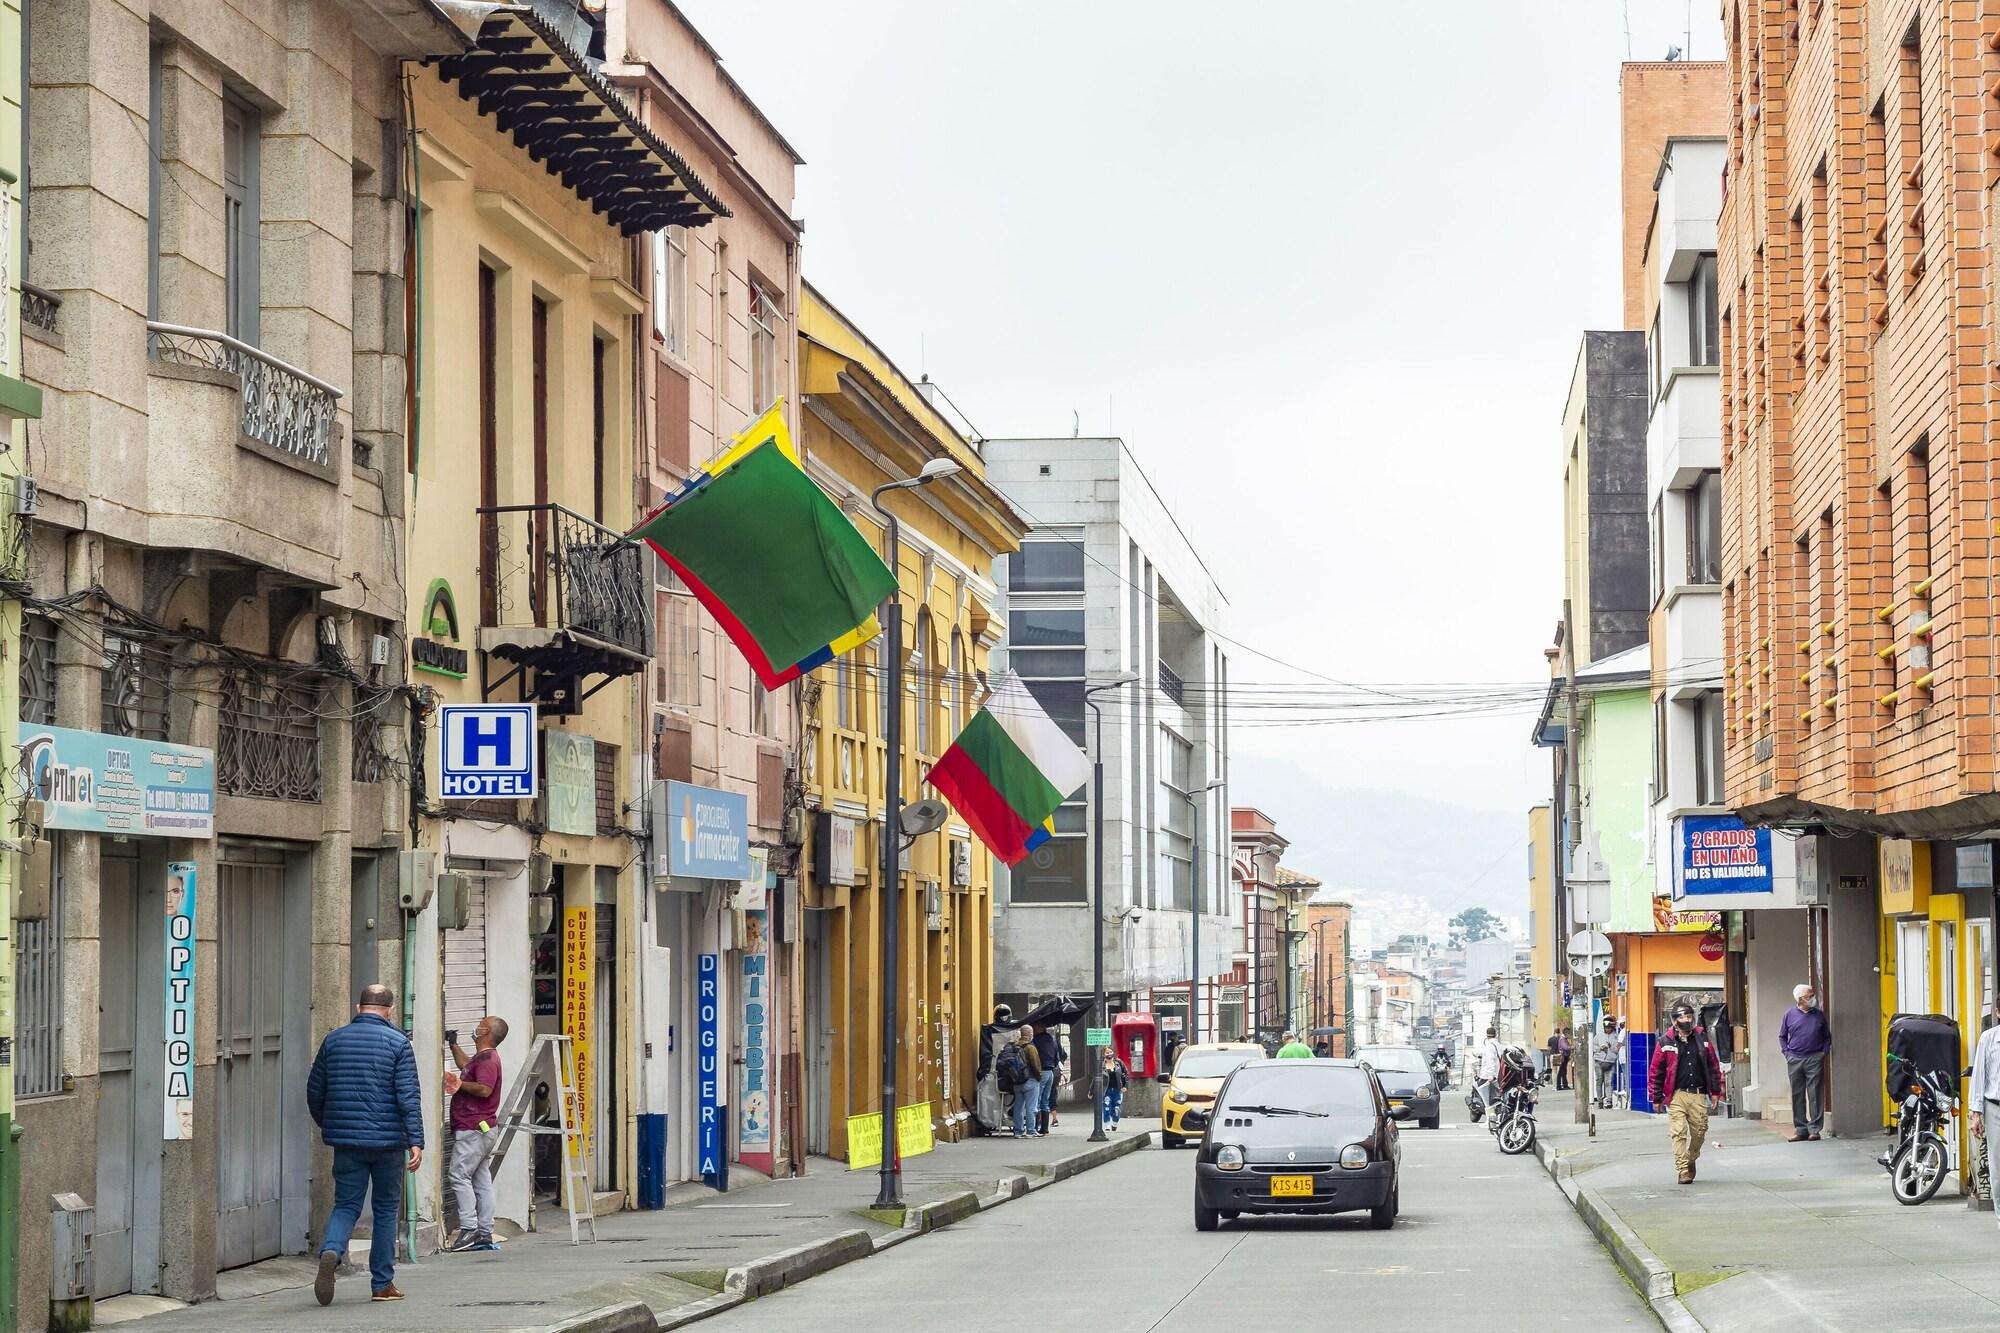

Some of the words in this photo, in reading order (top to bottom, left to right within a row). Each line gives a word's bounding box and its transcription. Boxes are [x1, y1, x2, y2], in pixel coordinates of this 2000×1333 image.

[463, 717, 512, 766] H
[107, 750, 131, 770] OPTICA
[444, 776, 530, 794] HOTEL
[1692, 832, 1701, 847] 2
[1703, 830, 1756, 847] GRADOS
[1693, 849, 1709, 866] EN
[1711, 849, 1729, 865] UN
[1731, 846, 1757, 865] AÑO
[1685, 868, 1698, 879] NO
[1700, 868, 1711, 879] ES
[1712, 864, 1766, 878] VALIDACIÓN
[1663, 911, 1679, 925] Los
[1680, 911, 1721, 925] Marinillos
[579, 911, 587, 971] NUEVAS
[1700, 943, 1724, 952] Coca-Cola
[744, 955, 766, 998] MI
[168, 915, 191, 1097] OPTICA
[578, 982, 586, 1041] USADAS
[745, 1003, 764, 1091] BEBE
[701, 955, 716, 1175] DROGUERÍA
[1272, 1180, 1291, 1191] KIS
[1293, 1180, 1312, 1191] 415
